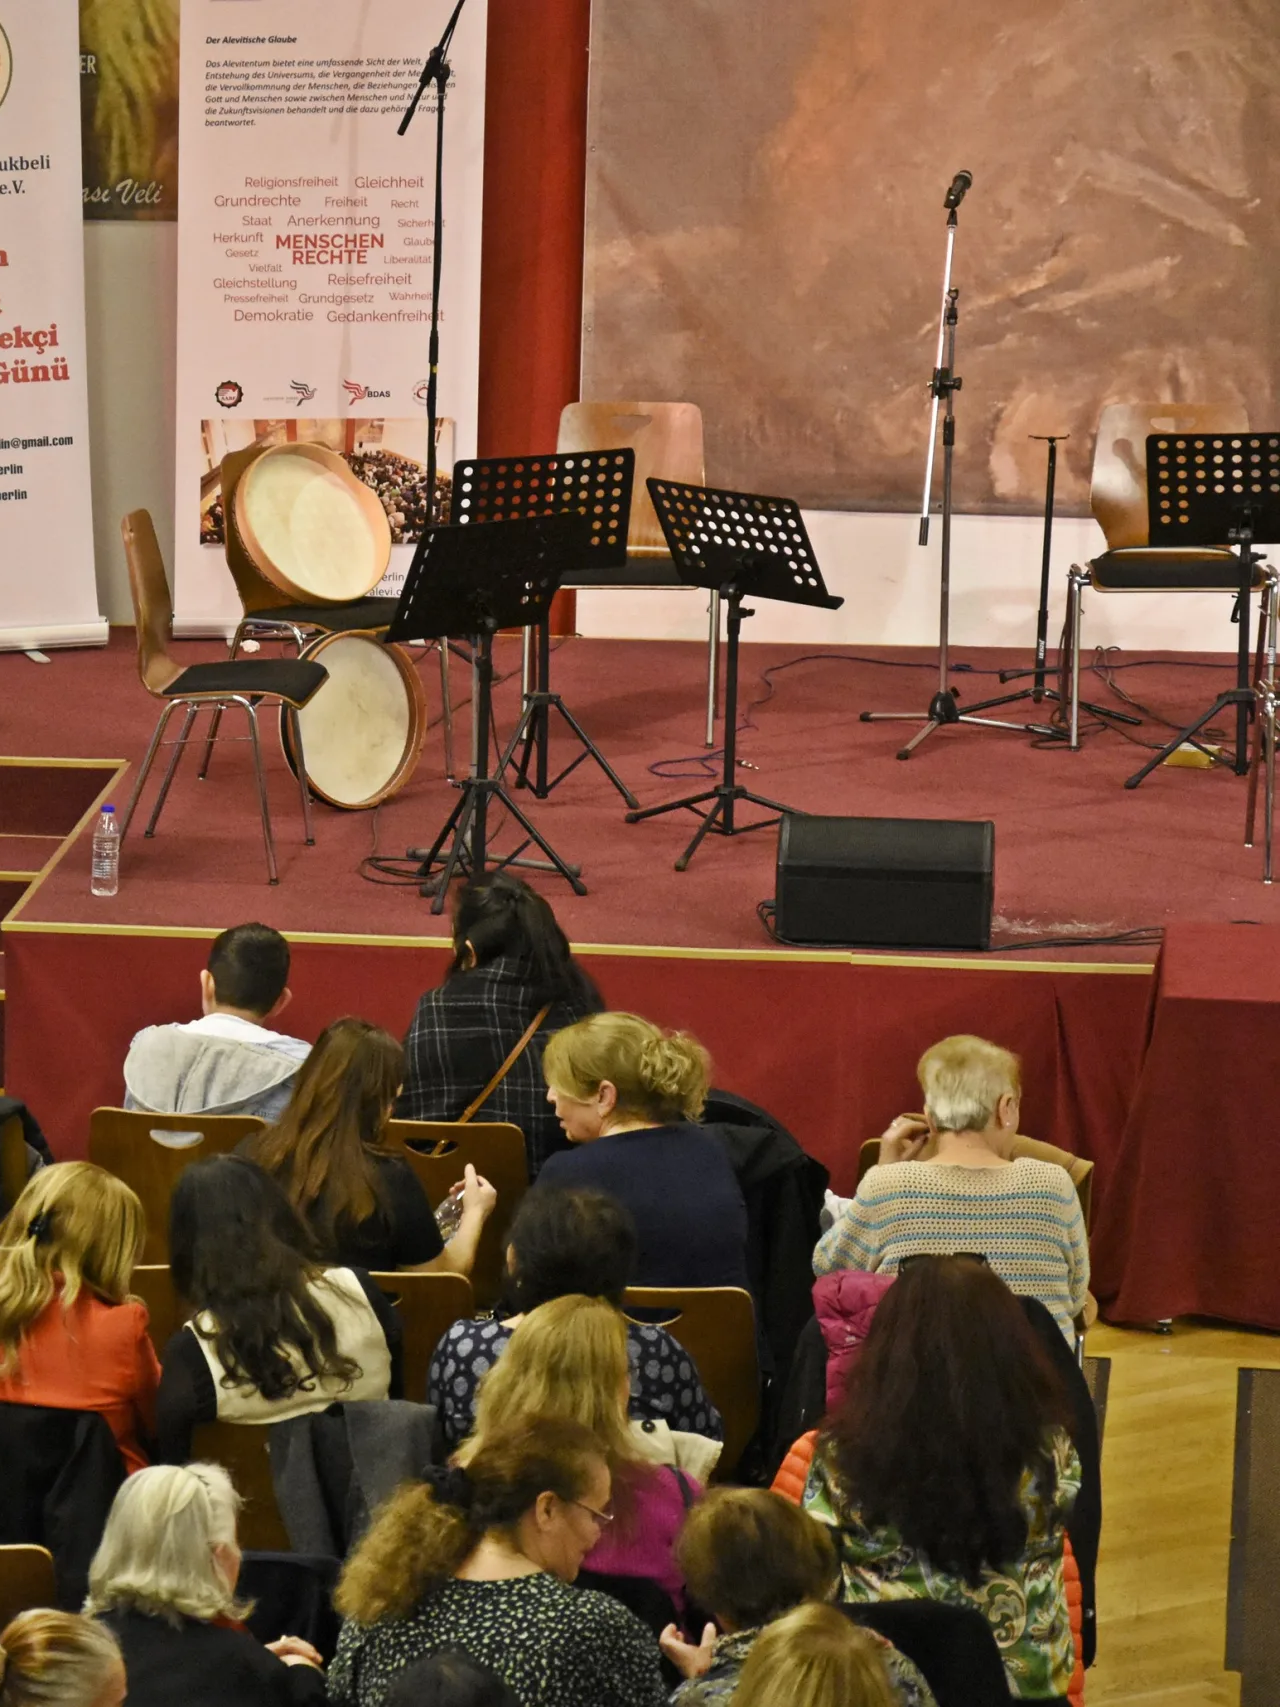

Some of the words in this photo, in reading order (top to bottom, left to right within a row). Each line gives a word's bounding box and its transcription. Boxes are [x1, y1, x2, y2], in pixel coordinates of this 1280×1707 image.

[205, 36, 221, 45] Der
[222, 35, 266, 45] Alevitische
[267, 35, 298, 45] Glaube
[79, 54, 97, 74] ER
[205, 60, 221, 68] Das
[222, 60, 270, 68] Alevitentum
[272, 59, 295, 67] bietet
[316, 58, 365, 68] umfassende
[365, 58, 385, 66] Sicht
[387, 58, 400, 66] der
[403, 58, 423, 67] Welt,
[205, 71, 250, 81] Entstehung
[251, 71, 266, 79] des
[267, 70, 316, 80] Universums,
[318, 70, 330, 78] die
[333, 69, 390, 79] Vergangenheit
[392, 69, 406, 77] der
[205, 83, 217, 92] die
[293, 82, 306, 91] der
[308, 82, 350, 92] Menschen,
[353, 82, 365, 90] die
[367, 81, 418, 91] Beziehungen
[205, 95, 222, 103] Gott
[225, 95, 240, 103] und
[242, 94, 282, 103] Menschen
[284, 94, 307, 102] sowie
[309, 93, 345, 102] zwischen
[347, 93, 387, 102] Menschen
[389, 93, 405, 101] und
[431, 92, 448, 101] ud
[205, 107, 217, 115] die
[219, 106, 285, 116] Zukunftsvisionen
[287, 105, 327, 114] behandelt
[328, 105, 344, 114] und
[346, 105, 359, 114] die
[360, 105, 379, 114] dazu
[205, 118, 257, 127] beantwortet.
[245, 176, 339, 190] Religionsfreiheit
[355, 176, 424, 188] Gleichheit
[115, 178, 164, 205] Veli
[214, 194, 301, 207] Grundrechte
[324, 196, 368, 207] Freiheit
[391, 199, 419, 209] Recht
[242, 215, 272, 226] Staat
[287, 214, 380, 229] Anerkennung
[397, 218, 446, 228] Sicherht
[213, 231, 264, 243] Herkunft
[275, 233, 384, 249] MENSCHEN
[225, 248, 259, 258] Gesetz
[292, 249, 368, 265] RECHTE
[383, 254, 432, 265] Liberalität
[248, 264, 283, 273] Vielfalt
[213, 277, 297, 290] Gleichstellung
[328, 273, 412, 286] Reisefreiheit
[224, 293, 288, 303] Pressefreiheit
[298, 293, 375, 306] Grundgesetz
[388, 292, 434, 301] Wahrheit
[234, 308, 314, 322] Demokratie
[367, 390, 391, 398] BDAS
[381, 572, 405, 581] erlin
